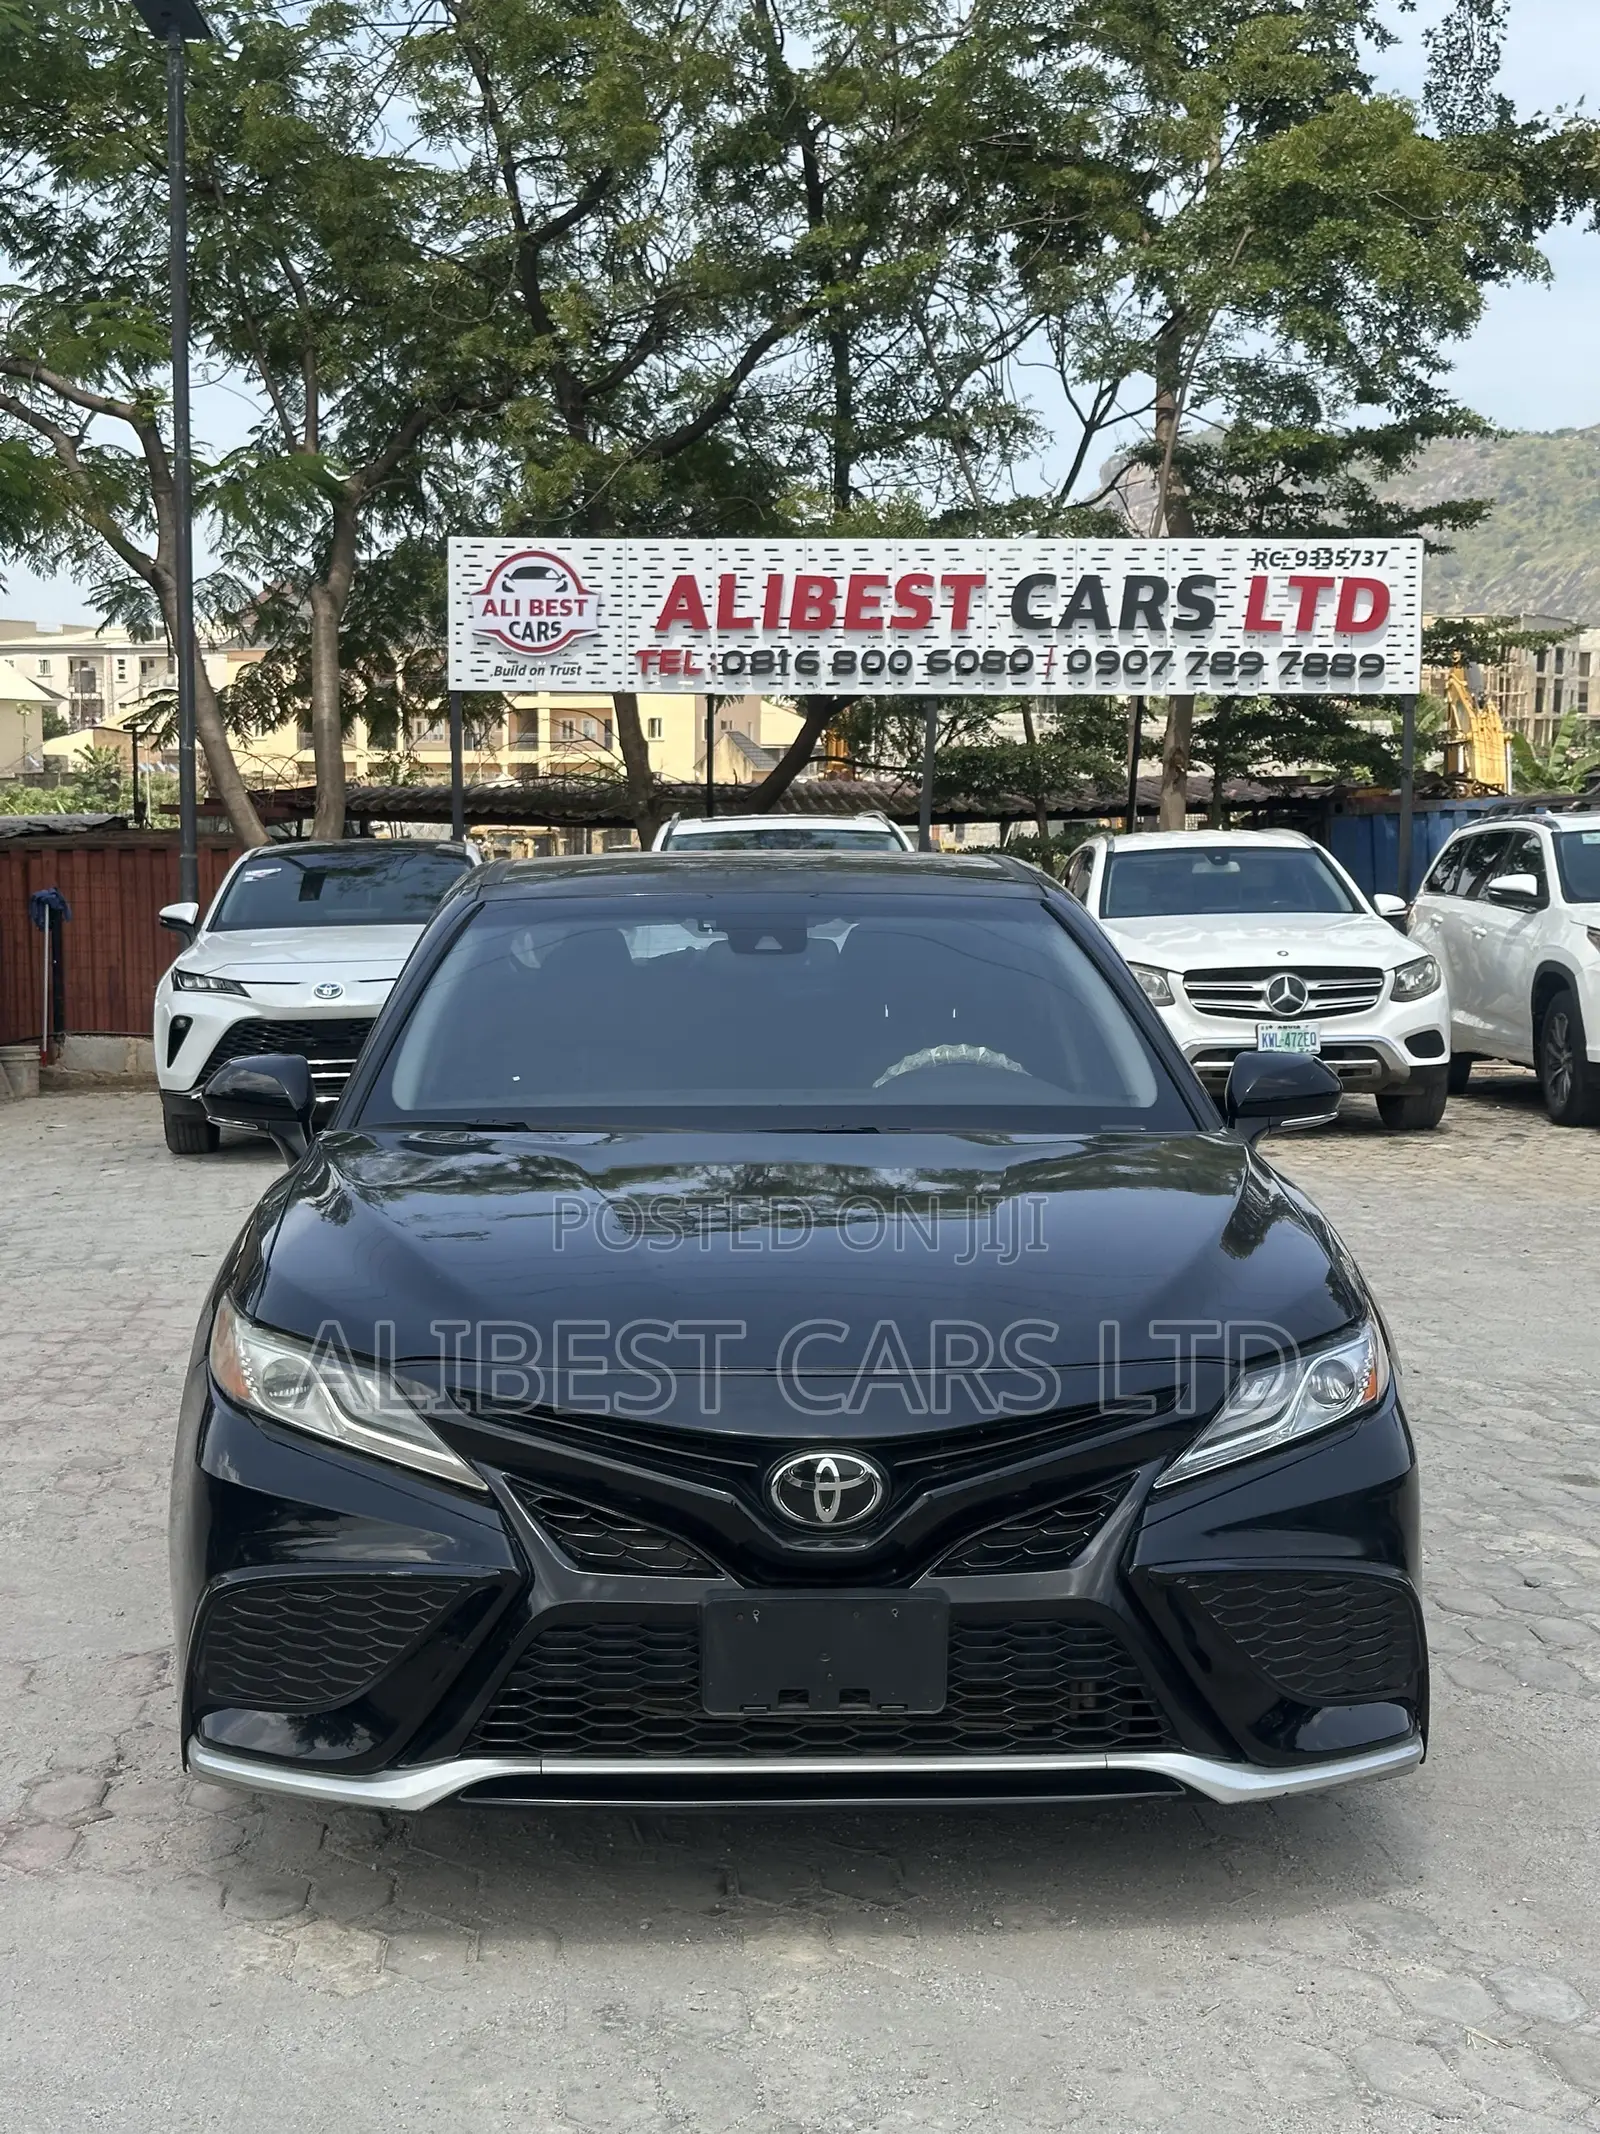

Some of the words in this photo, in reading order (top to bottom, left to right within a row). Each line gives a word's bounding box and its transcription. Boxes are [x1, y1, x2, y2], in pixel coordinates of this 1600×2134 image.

[1294, 550, 1389, 567] 9335737
[481, 599, 520, 617] ALI
[529, 599, 589, 617] BEST
[655, 573, 987, 631] ALIBEST
[1011, 573, 1217, 632] CARS
[1243, 575, 1391, 633] LTD
[508, 621, 562, 642] CARS
[493, 664, 526, 677] Build
[529, 666, 546, 676] on
[550, 664, 582, 676] Trust
[721, 649, 820, 675] 0816
[831, 649, 913, 675] 800
[925, 649, 1034, 675] 6080
[1066, 649, 1173, 675] 0907
[1186, 651, 1264, 677] 789
[1277, 651, 1385, 678] 7889
